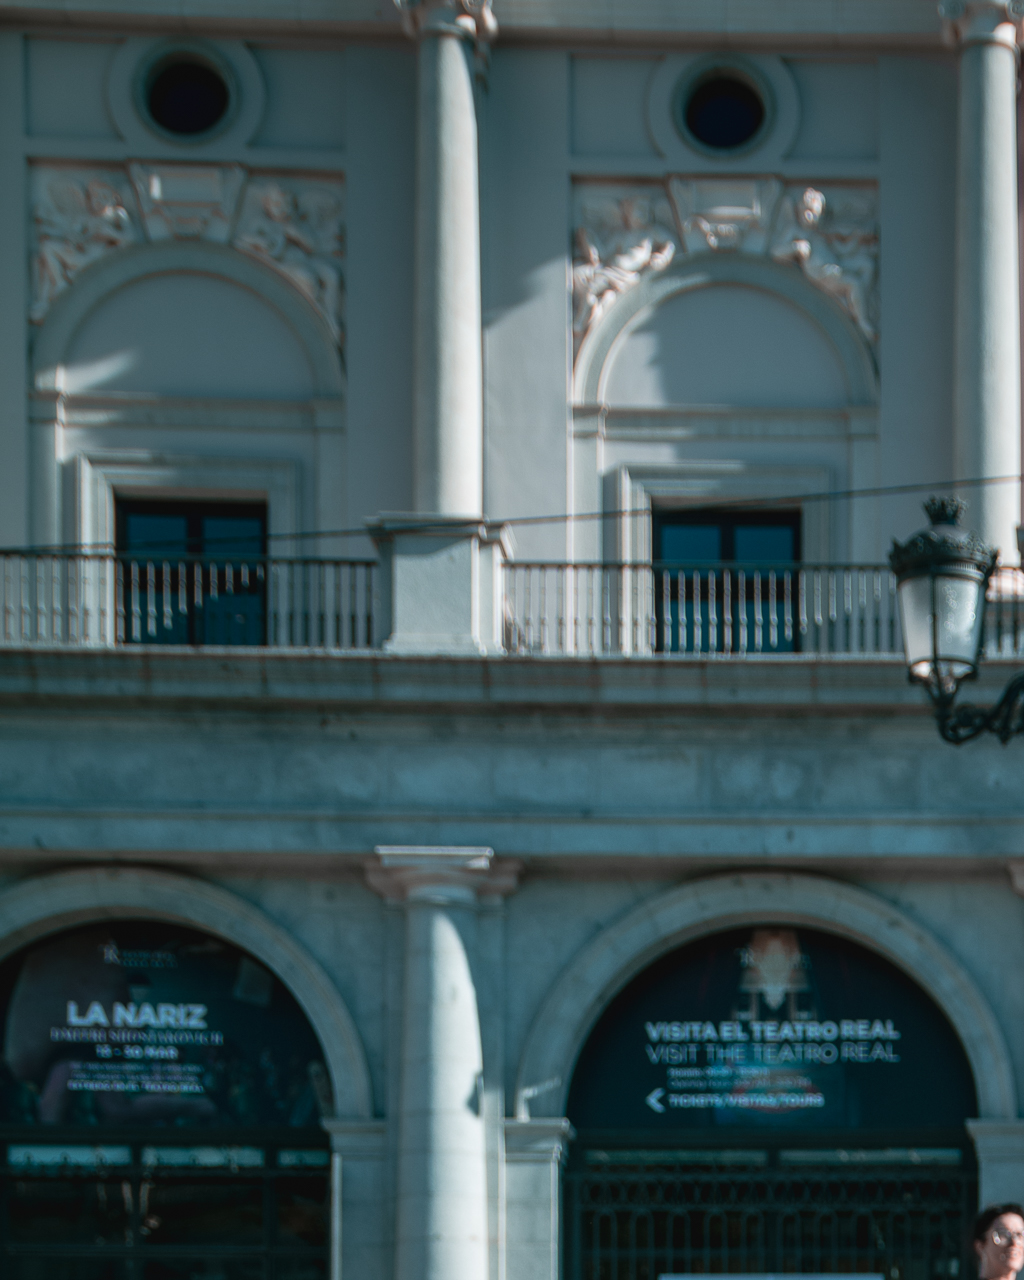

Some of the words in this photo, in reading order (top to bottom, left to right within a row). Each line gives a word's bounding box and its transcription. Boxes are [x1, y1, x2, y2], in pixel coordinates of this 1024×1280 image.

[67, 1000, 109, 1026] LA
[112, 1002, 208, 1029] NARIZ
[645, 1021, 718, 1042] VISITA
[720, 1021, 748, 1042] EL
[752, 1021, 838, 1042] TEATRO
[840, 1019, 900, 1040] REAL
[646, 1043, 699, 1064] VISIT
[704, 1043, 748, 1063] THE
[752, 1042, 838, 1064] TEATRO
[840, 1041, 900, 1063] REAL
